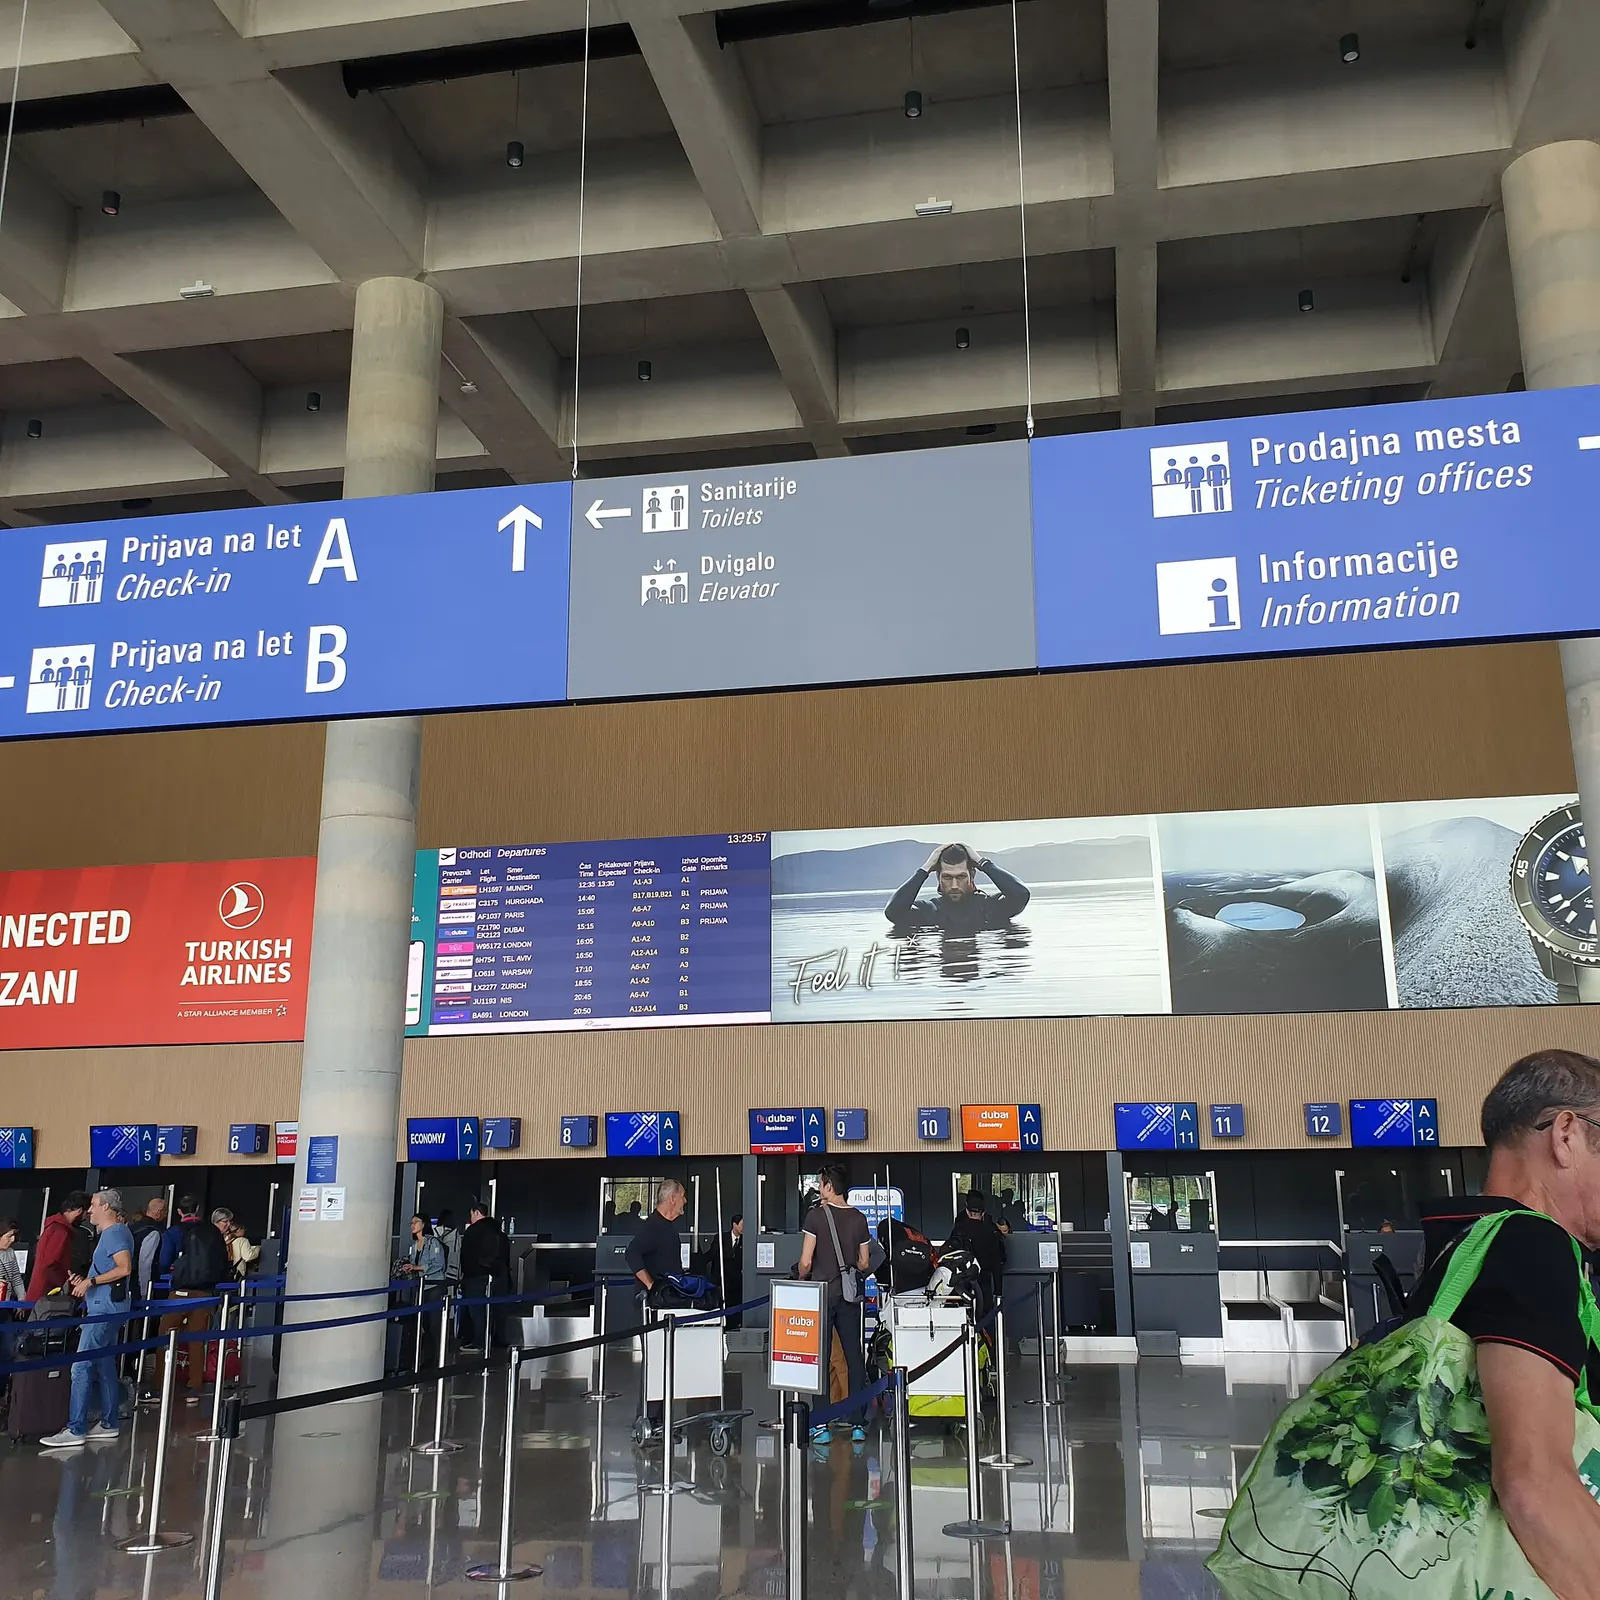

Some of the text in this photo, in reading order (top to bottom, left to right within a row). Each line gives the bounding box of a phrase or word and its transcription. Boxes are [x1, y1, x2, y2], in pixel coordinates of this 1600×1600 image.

[1250, 418, 1521, 467] Prodajna mesta
[700, 476, 797, 502] Sanitarije
[1253, 460, 1533, 509] Ticketing offices
[701, 507, 764, 529] Toilets
[122, 523, 302, 566] Prijava na let
[307, 517, 359, 585] A
[701, 551, 775, 577] Dvigalo
[1258, 540, 1459, 583] Informacije
[116, 567, 232, 602] Check-in
[699, 580, 780, 603] Elevator
[1260, 587, 1460, 628] Information
[110, 629, 293, 673] Prijava na let
[305, 624, 348, 694] B
[104, 674, 222, 708] Check-in
[728, 833, 767, 843] 13:29:57
[460, 847, 547, 859] Odhodi Departures
[579, 861, 592, 869] Čas
[633, 860, 655, 868] Prijava
[681, 857, 698, 865] Izhod
[701, 856, 727, 864] Opombe
[1516, 859, 1529, 879] 45
[506, 873, 540, 881] Destination
[598, 869, 627, 878] Expected
[701, 863, 728, 871] Remarks
[505, 884, 533, 892] MUNICH
[597, 880, 615, 888] 13:30
[633, 878, 652, 886] A1-A3
[505, 897, 544, 906] HURGHADA
[578, 894, 596, 902] 14:40
[681, 889, 690, 897] B1
[700, 888, 728, 896] PRIJAVA
[504, 911, 525, 919] PARIS
[680, 903, 690, 911] A2
[700, 902, 728, 910] PRIJAVA
[504, 926, 525, 935] DUBAI
[577, 923, 595, 931] 15:15
[680, 917, 690, 925] B3
[699, 917, 728, 925] PRIJAVA
[503, 941, 532, 949] LONDON
[631, 935, 651, 943] A1-A2
[680, 933, 690, 941] B2
[185, 938, 292, 962] TURKISH
[502, 954, 515, 963] TEL
[516, 954, 533, 962] AVIV
[630, 949, 658, 957] A12-A14
[680, 947, 689, 955] B3
[180, 962, 291, 986] AIRLINES
[501, 968, 533, 977] WARSAW
[575, 965, 593, 973] 17:10
[679, 960, 689, 968] A3
[788, 948, 849, 1005] Feel
[0, 969, 78, 1007] ZANI
[501, 982, 527, 991] ZURICH
[574, 979, 592, 988] 18:55
[630, 976, 650, 985] A1-A2
[679, 975, 689, 983] A2
[500, 996, 512, 1004] NIS
[679, 989, 688, 997] B1
[184, 1010, 202, 1018] STAR
[203, 1009, 238, 1017] ALLIANCE
[240, 1008, 273, 1016] MEMBER
[500, 1010, 529, 1019] LONDON
[629, 1004, 657, 1013] A12-A14
[679, 1003, 688, 1011] B3
[809, 1113, 819, 1125] A
[1024, 1110, 1035, 1122] A
[1180, 1108, 1191, 1121] A
[1419, 1105, 1430, 1118] A
[463, 1123, 473, 1134] A
[663, 1117, 673, 1129] A
[837, 1121, 846, 1137] 9
[921, 1119, 938, 1136] 10
[1215, 1116, 1231, 1133] 11
[1312, 1115, 1331, 1133] 12
[18, 1132, 27, 1143] A
[142, 1130, 152, 1141] A
[255, 1135, 260, 1150] 6
[410, 1132, 442, 1144] ECONOMY
[485, 1130, 493, 1145] 7
[563, 1127, 571, 1144] 8
[810, 1135, 818, 1147] 9
[1023, 1132, 1039, 1145] 10
[1179, 1131, 1194, 1144] 11
[1418, 1128, 1435, 1141] 12
[158, 1137, 165, 1152] 5
[181, 1136, 187, 1152] 5
[231, 1135, 239, 1151] 6
[465, 1143, 472, 1155] 7
[665, 1139, 673, 1151] 8
[19, 1153, 26, 1163] 4
[144, 1150, 152, 1161] 5
[786, 1329, 808, 1337] Economy
